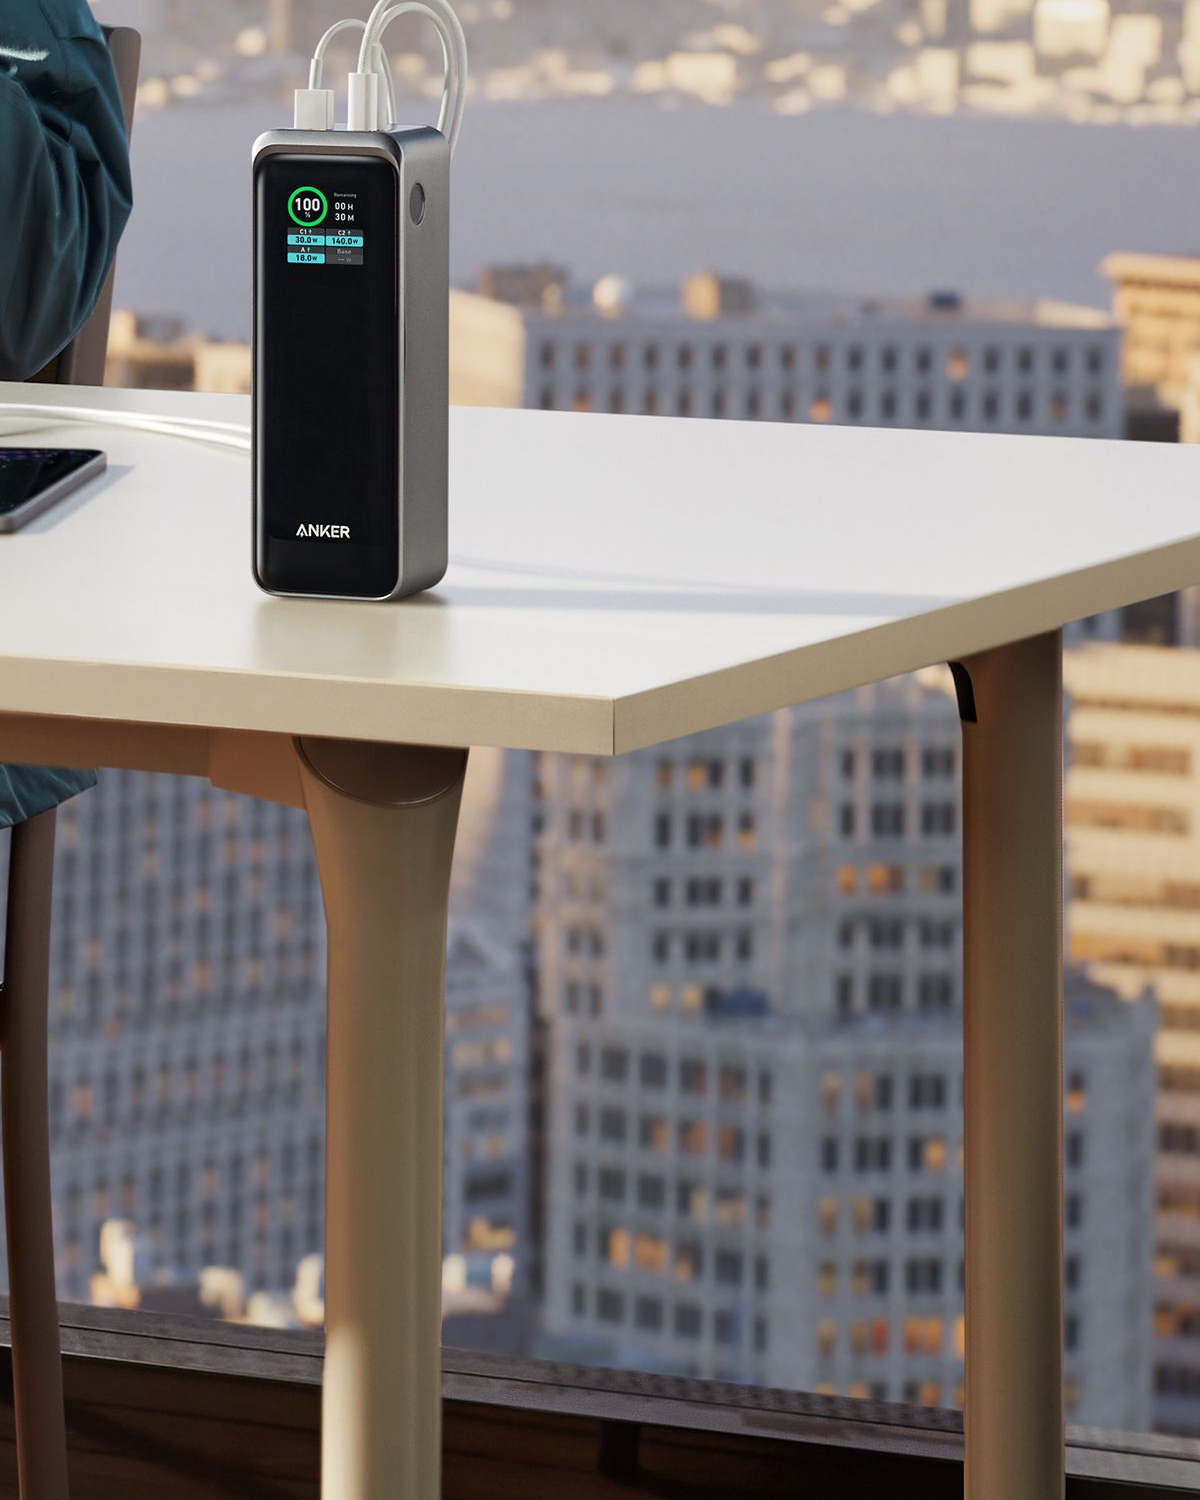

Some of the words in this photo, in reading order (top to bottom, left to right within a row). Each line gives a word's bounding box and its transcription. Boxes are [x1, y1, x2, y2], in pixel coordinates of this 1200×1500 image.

[295, 197, 320, 212] 100
[334, 202, 346, 210] 00
[347, 203, 354, 211] H
[334, 213, 346, 221] 30
[295, 523, 351, 539] ANKER
